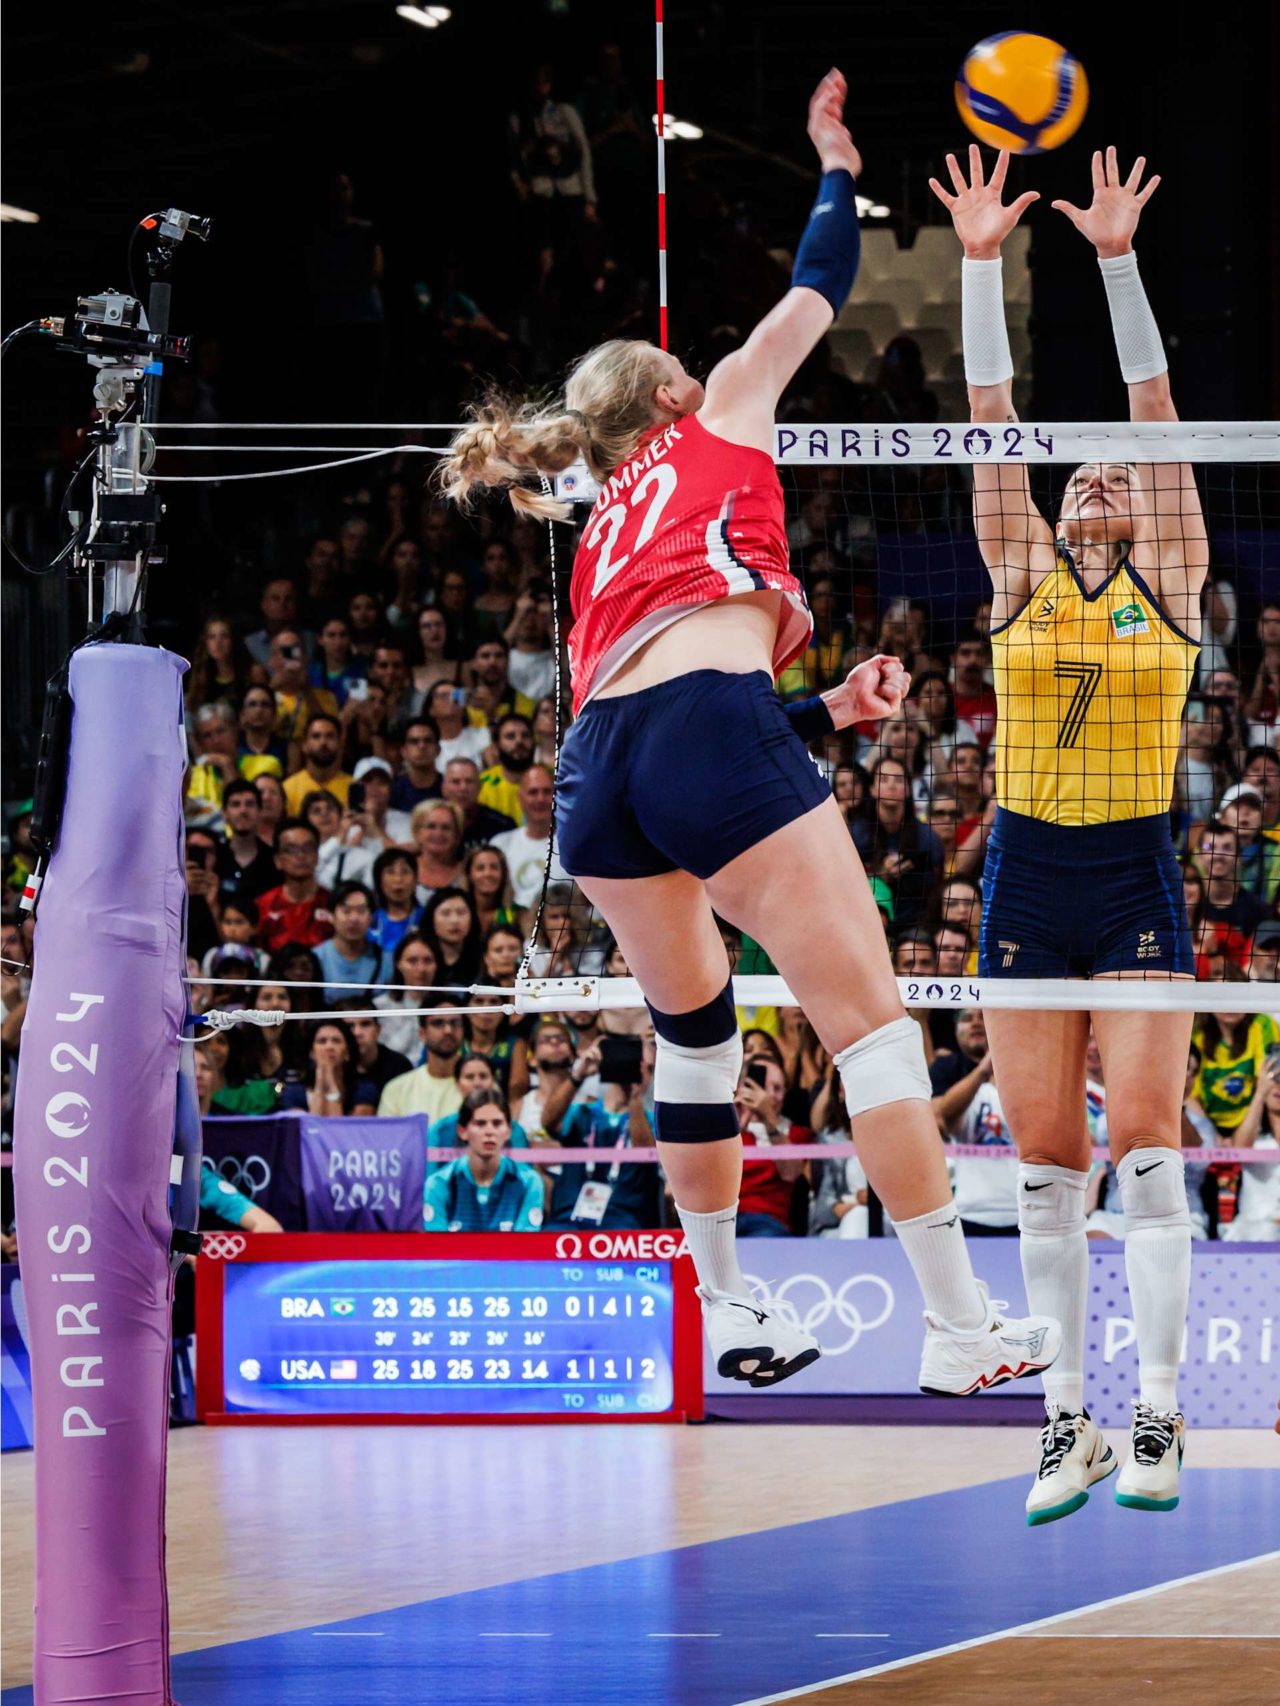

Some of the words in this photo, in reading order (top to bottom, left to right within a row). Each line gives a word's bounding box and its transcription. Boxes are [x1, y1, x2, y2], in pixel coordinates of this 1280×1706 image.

[932, 427, 1053, 457] 2024
[580, 423, 683, 543] UMMER
[586, 463, 678, 601] 22
[1116, 624, 1148, 637] BRASIL
[1054, 658, 1103, 749] 7
[998, 940, 1020, 968] 7
[907, 983, 980, 1001] 2024
[43, 992, 105, 1187] 2024
[330, 1182, 402, 1212] 2024
[588, 1233, 692, 1259] OMEGA
[561, 1267, 583, 1282] TO
[596, 1267, 625, 1282] SUB
[635, 1266, 660, 1282] CH
[281, 1297, 325, 1319] BRA
[372, 1297, 399, 1318] 23
[409, 1297, 437, 1318] 25
[447, 1297, 473, 1318] 15
[484, 1296, 511, 1317] 25
[521, 1296, 548, 1317] 10
[565, 1296, 580, 1317] 0
[602, 1297, 617, 1317] 4
[640, 1295, 655, 1317] 2
[281, 1360, 325, 1381] USA
[373, 1359, 400, 1380] 25
[410, 1360, 437, 1380] 18
[447, 1359, 474, 1380] 25
[484, 1359, 511, 1380] 23
[521, 1359, 549, 1380] 14
[566, 1359, 581, 1379] 1
[604, 1359, 618, 1379] 1
[640, 1358, 656, 1379] 2
[562, 1393, 585, 1408] TO
